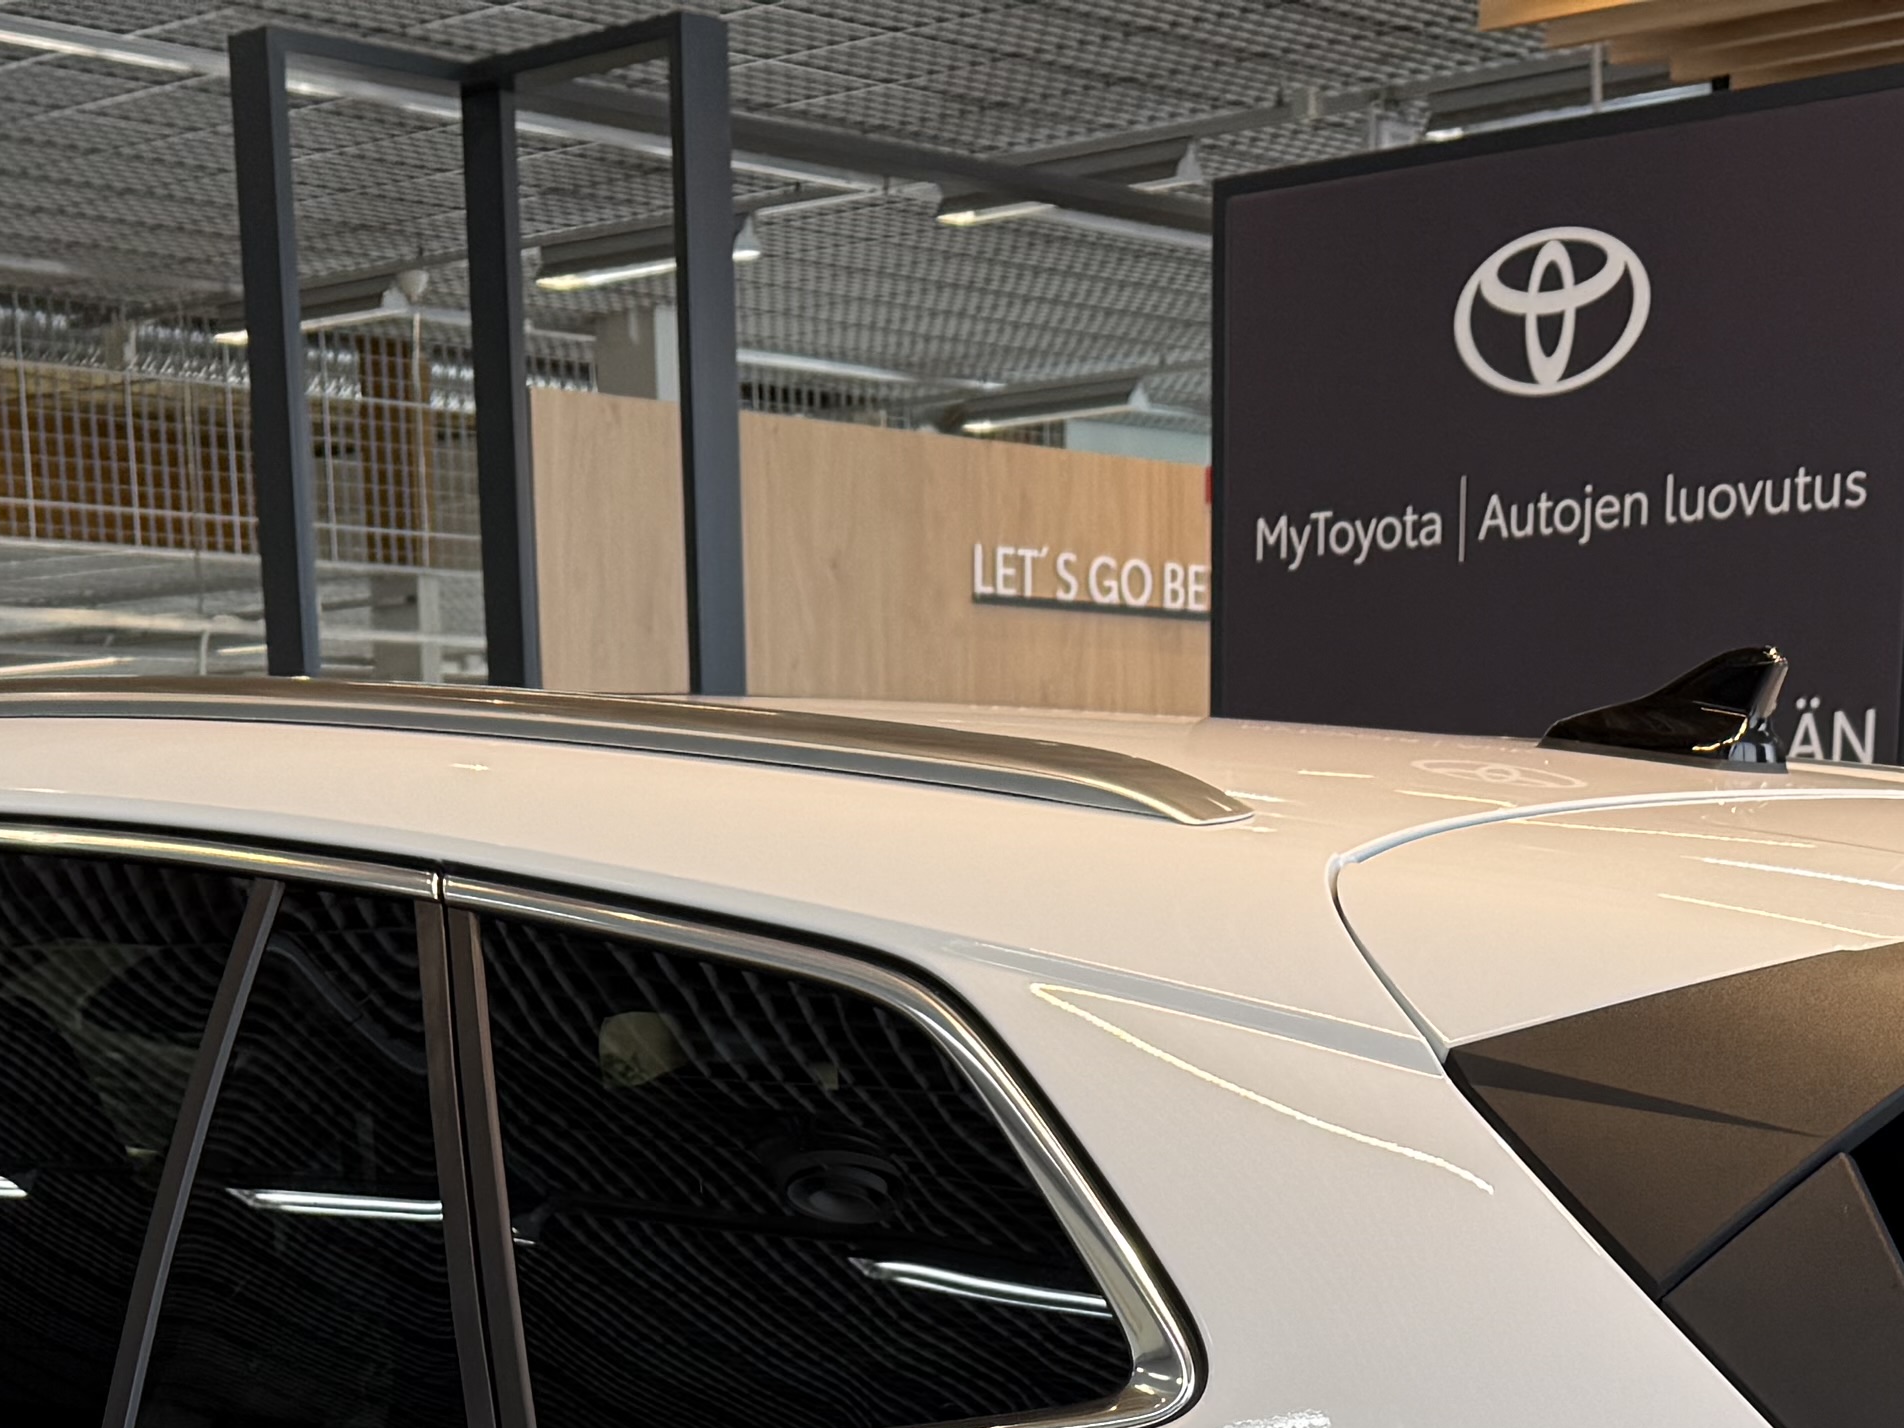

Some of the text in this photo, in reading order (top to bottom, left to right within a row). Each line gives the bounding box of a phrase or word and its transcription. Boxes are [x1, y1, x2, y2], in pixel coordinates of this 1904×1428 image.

[1256, 467, 1868, 571] MyToyota Autojen luovutus
[1089, 556, 1153, 607] GO
